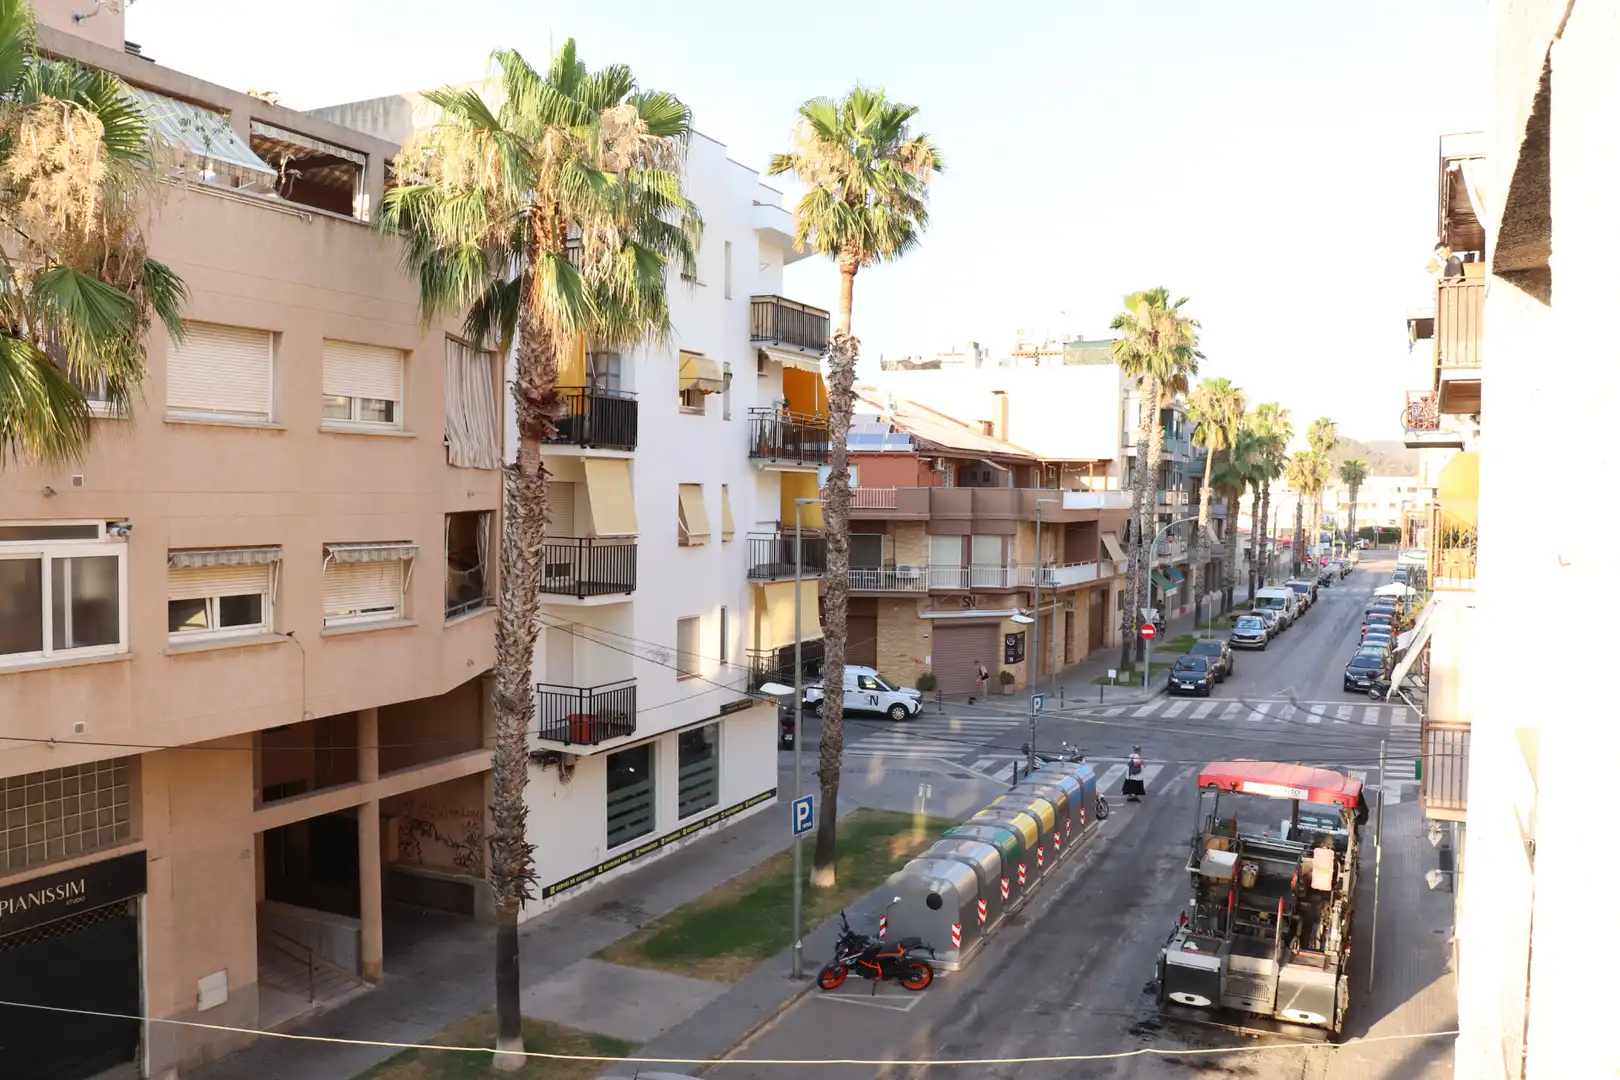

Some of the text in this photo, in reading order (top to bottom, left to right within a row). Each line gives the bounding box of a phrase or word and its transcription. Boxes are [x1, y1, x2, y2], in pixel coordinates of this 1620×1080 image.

[1034, 697, 1041, 715] P
[797, 802, 809, 830] P
[0, 878, 85, 917] PIANISSIM
